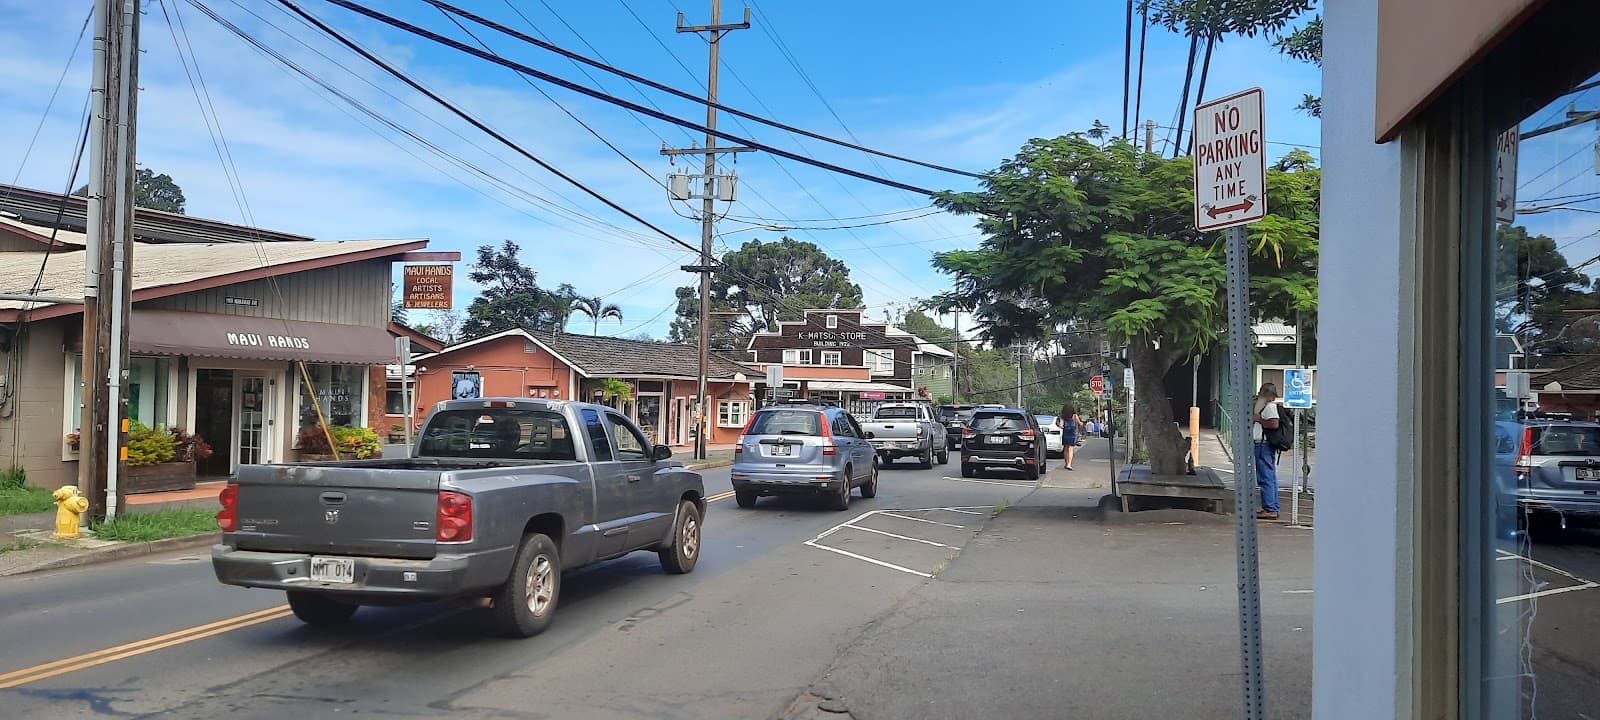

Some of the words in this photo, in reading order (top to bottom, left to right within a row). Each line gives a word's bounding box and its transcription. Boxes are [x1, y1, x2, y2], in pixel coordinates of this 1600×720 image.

[1215, 106, 1240, 135] NO
[1199, 129, 1259, 167] PARKING
[1215, 161, 1242, 182] ANY
[1213, 179, 1246, 201] TIME
[404, 265, 424, 276] MAUI
[424, 265, 452, 276] HANDS
[416, 276, 439, 284] LOCAL
[412, 284, 443, 292] ARTISTS
[409, 292, 445, 300] ARTISANS
[226, 332, 263, 347] MAUI
[267, 335, 310, 349] HANDS
[839, 331, 867, 340] STORE
[319, 388, 345, 396] MAUI
